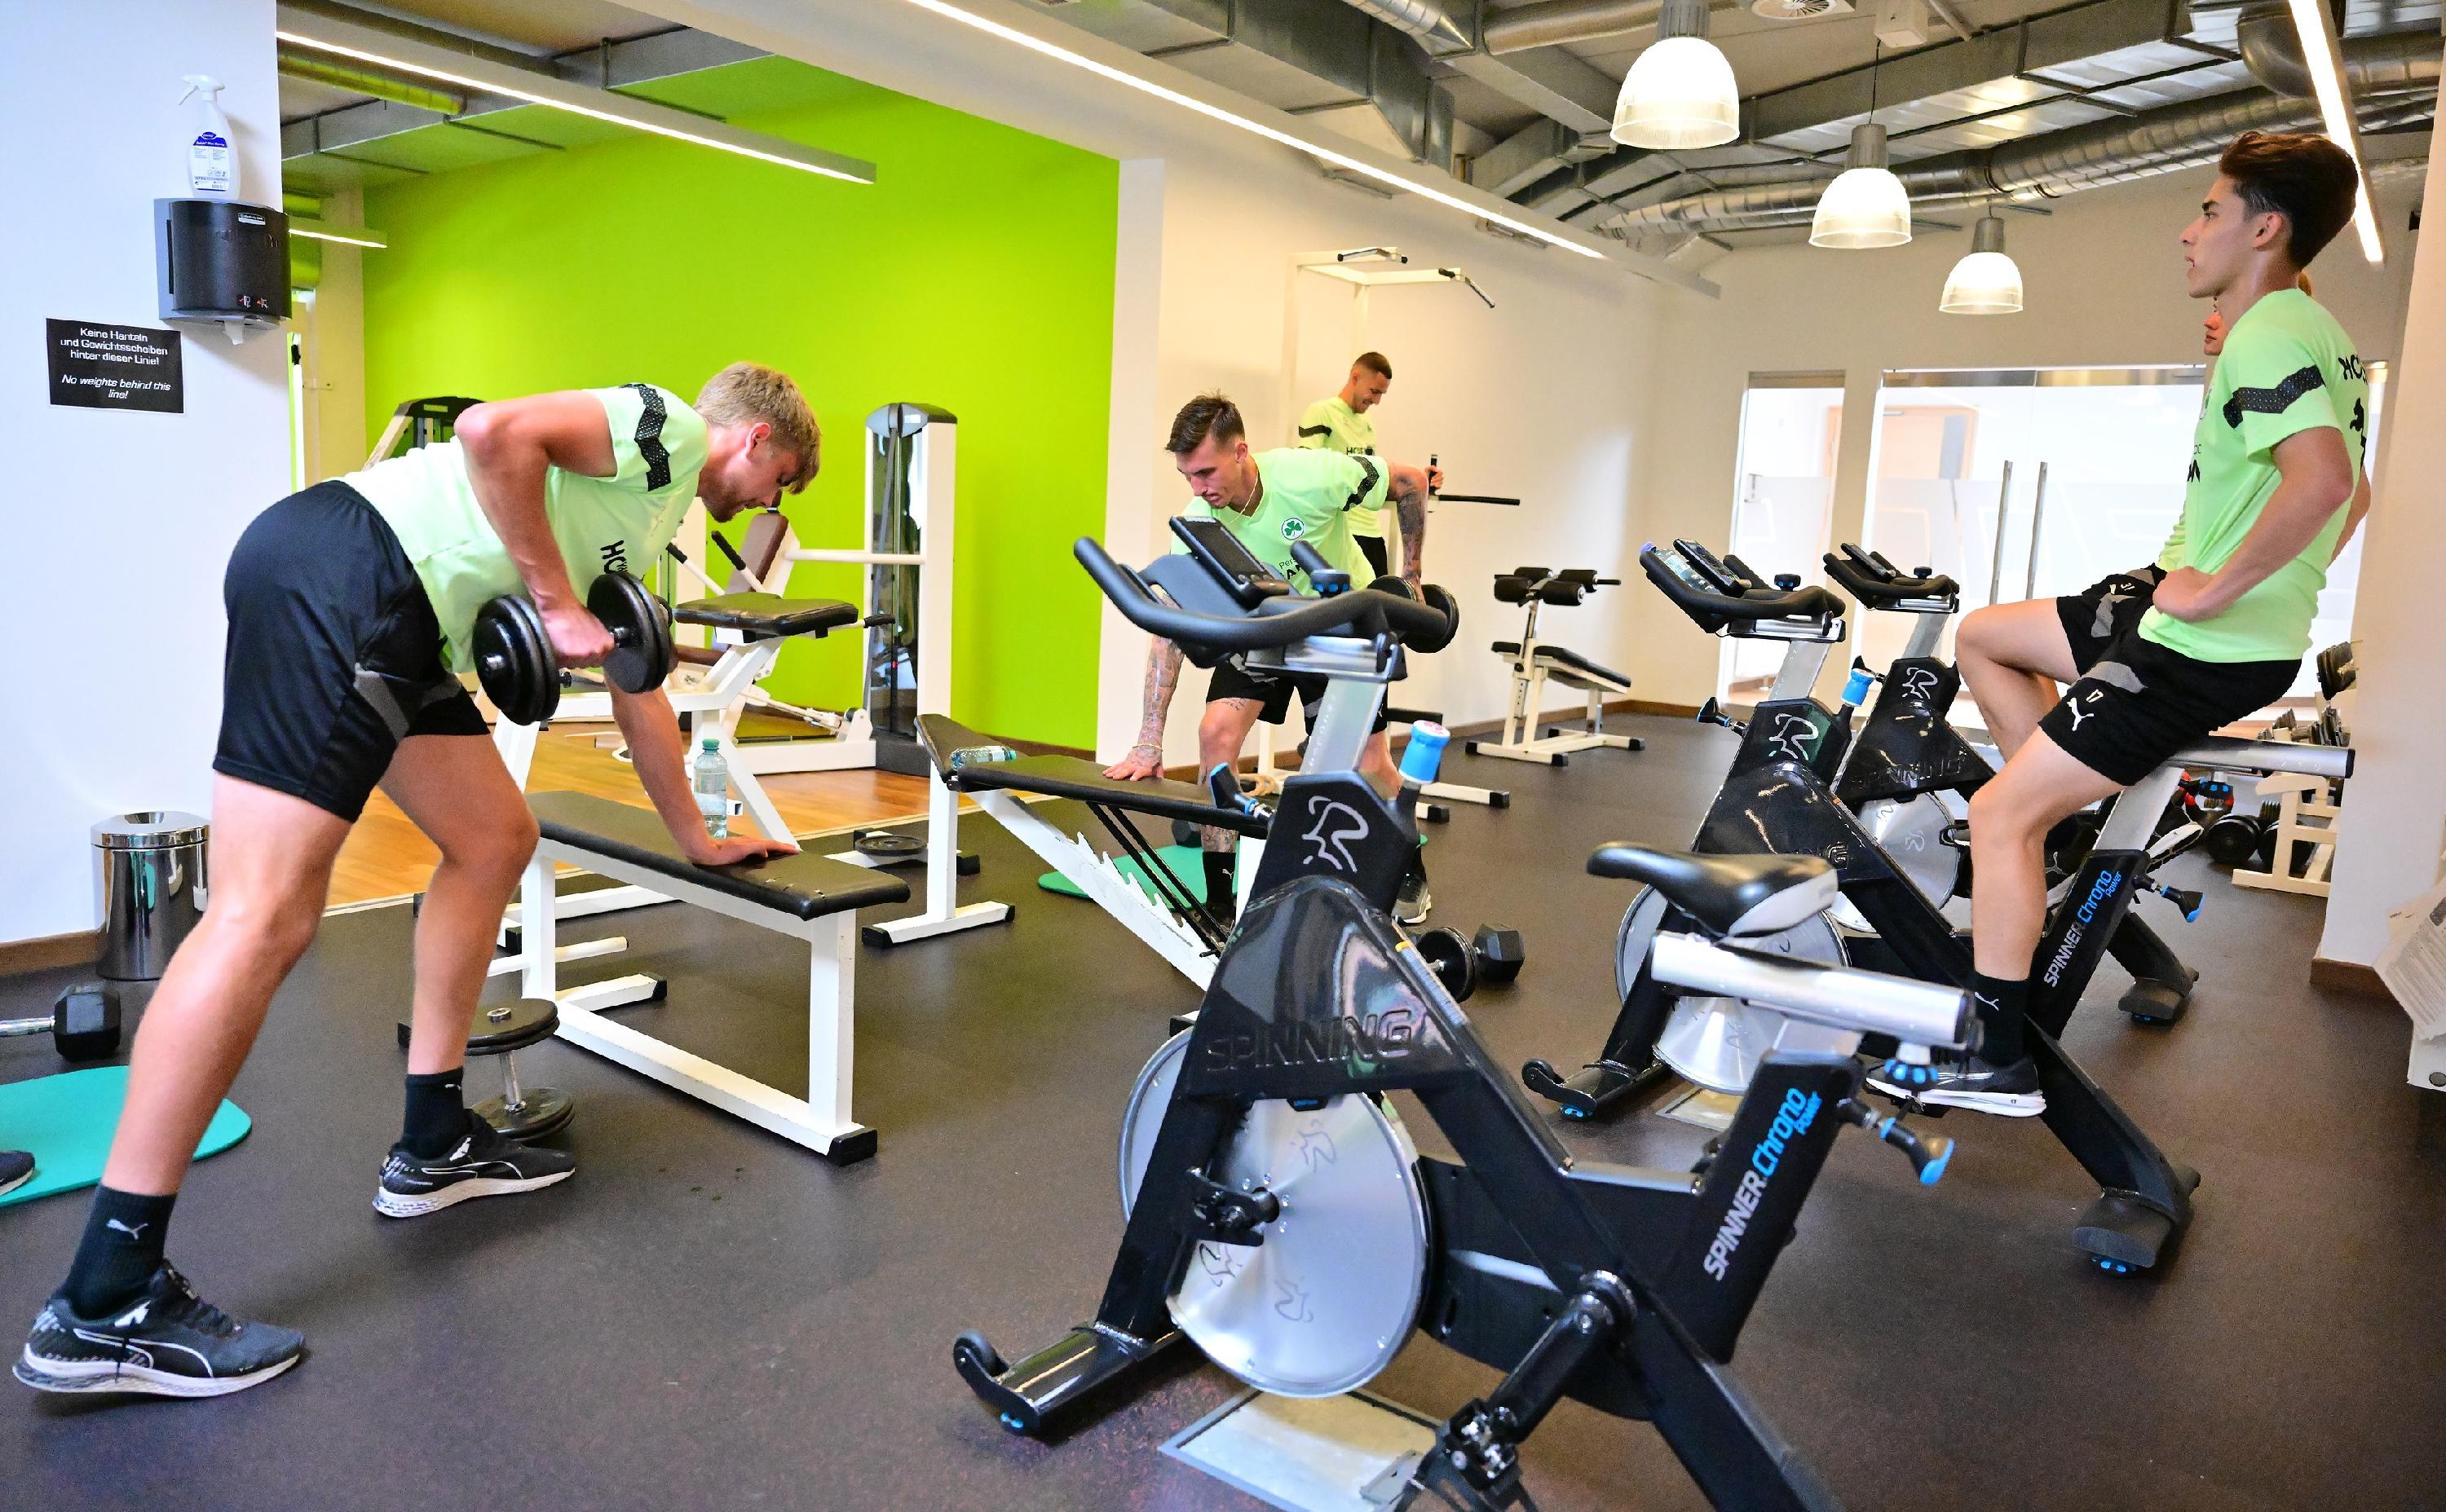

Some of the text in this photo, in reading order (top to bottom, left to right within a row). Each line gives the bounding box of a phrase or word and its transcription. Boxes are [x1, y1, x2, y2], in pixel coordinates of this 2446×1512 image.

[80, 328, 148, 342] Keine Hanteln
[60, 338, 168, 355] und Gewichtsscheiben
[70, 350, 160, 365] hinter dieser Linie!
[61, 374, 171, 391] No weights behind this
[108, 389, 130, 399] line!
[2086, 689, 2104, 703] 17
[2105, 871, 2122, 897] Power
[2043, 870, 2113, 988] SPINNER Chrono
[1206, 1009, 1413, 1071] SPINNING
[1702, 1087, 1808, 1282] SPINNER Chrono
